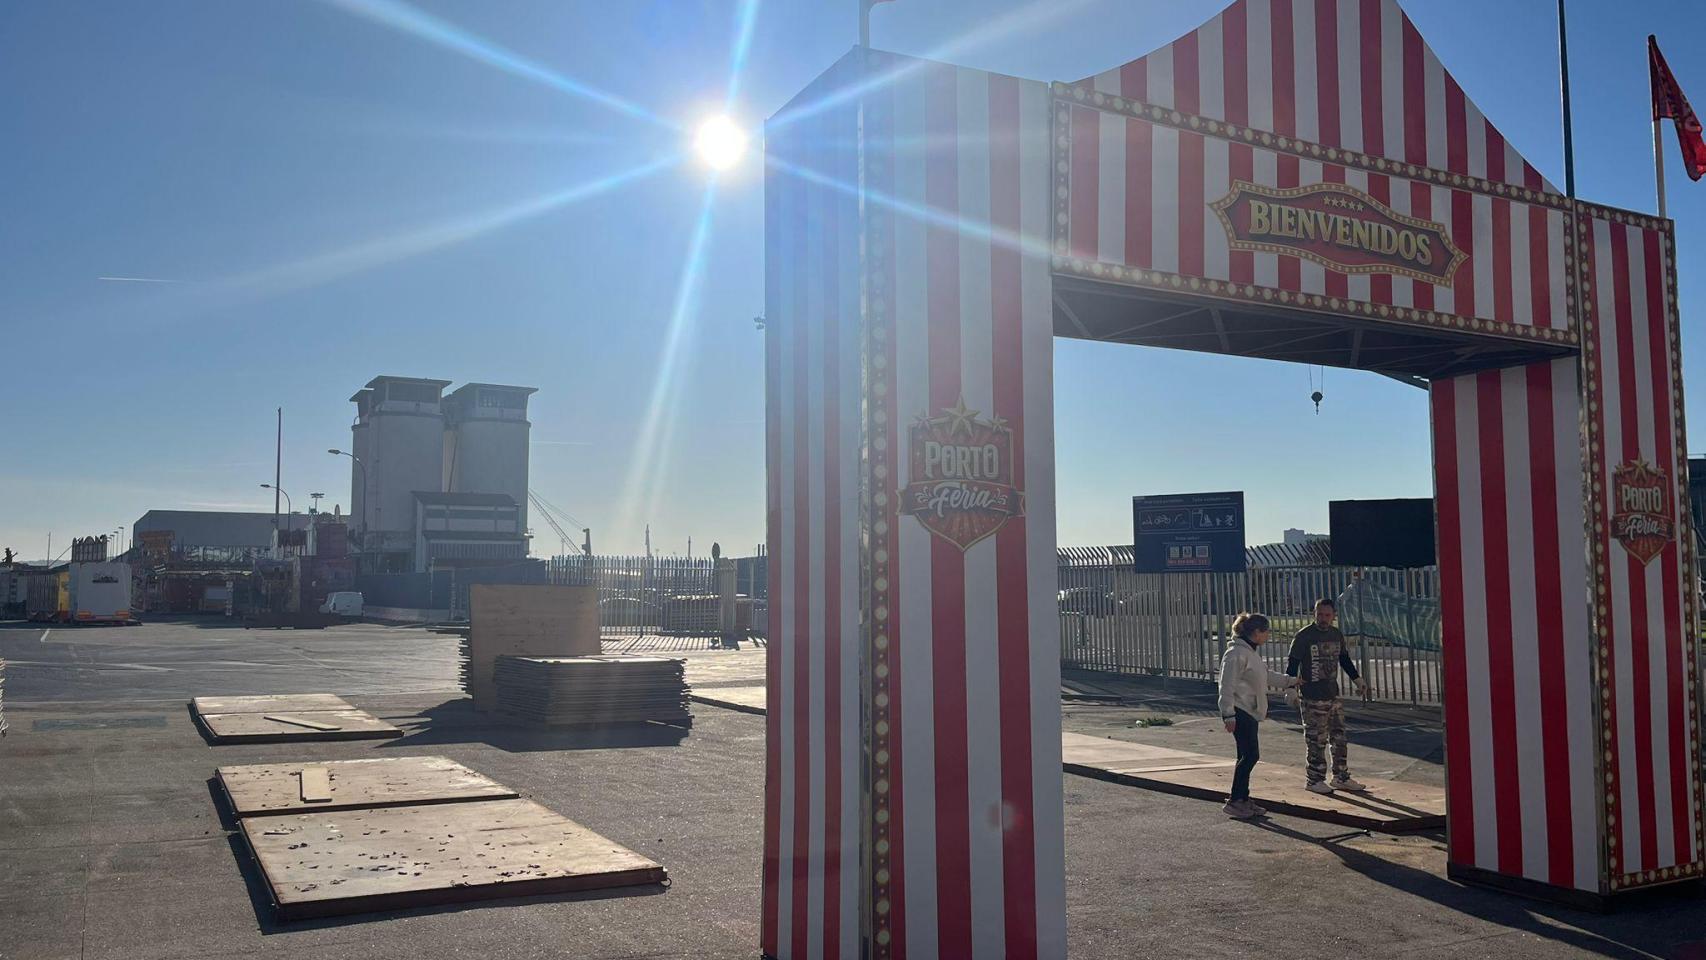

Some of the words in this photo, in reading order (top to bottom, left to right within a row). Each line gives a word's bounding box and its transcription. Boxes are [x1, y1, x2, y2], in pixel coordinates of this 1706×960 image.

[1249, 199, 1432, 265] BIENVENIDOS
[925, 441, 999, 480] PORTO
[928, 481, 998, 518] Feria
[1622, 484, 1662, 513] PORTO
[1625, 514, 1660, 541] Feria
[1311, 645, 1320, 682] WANTED
